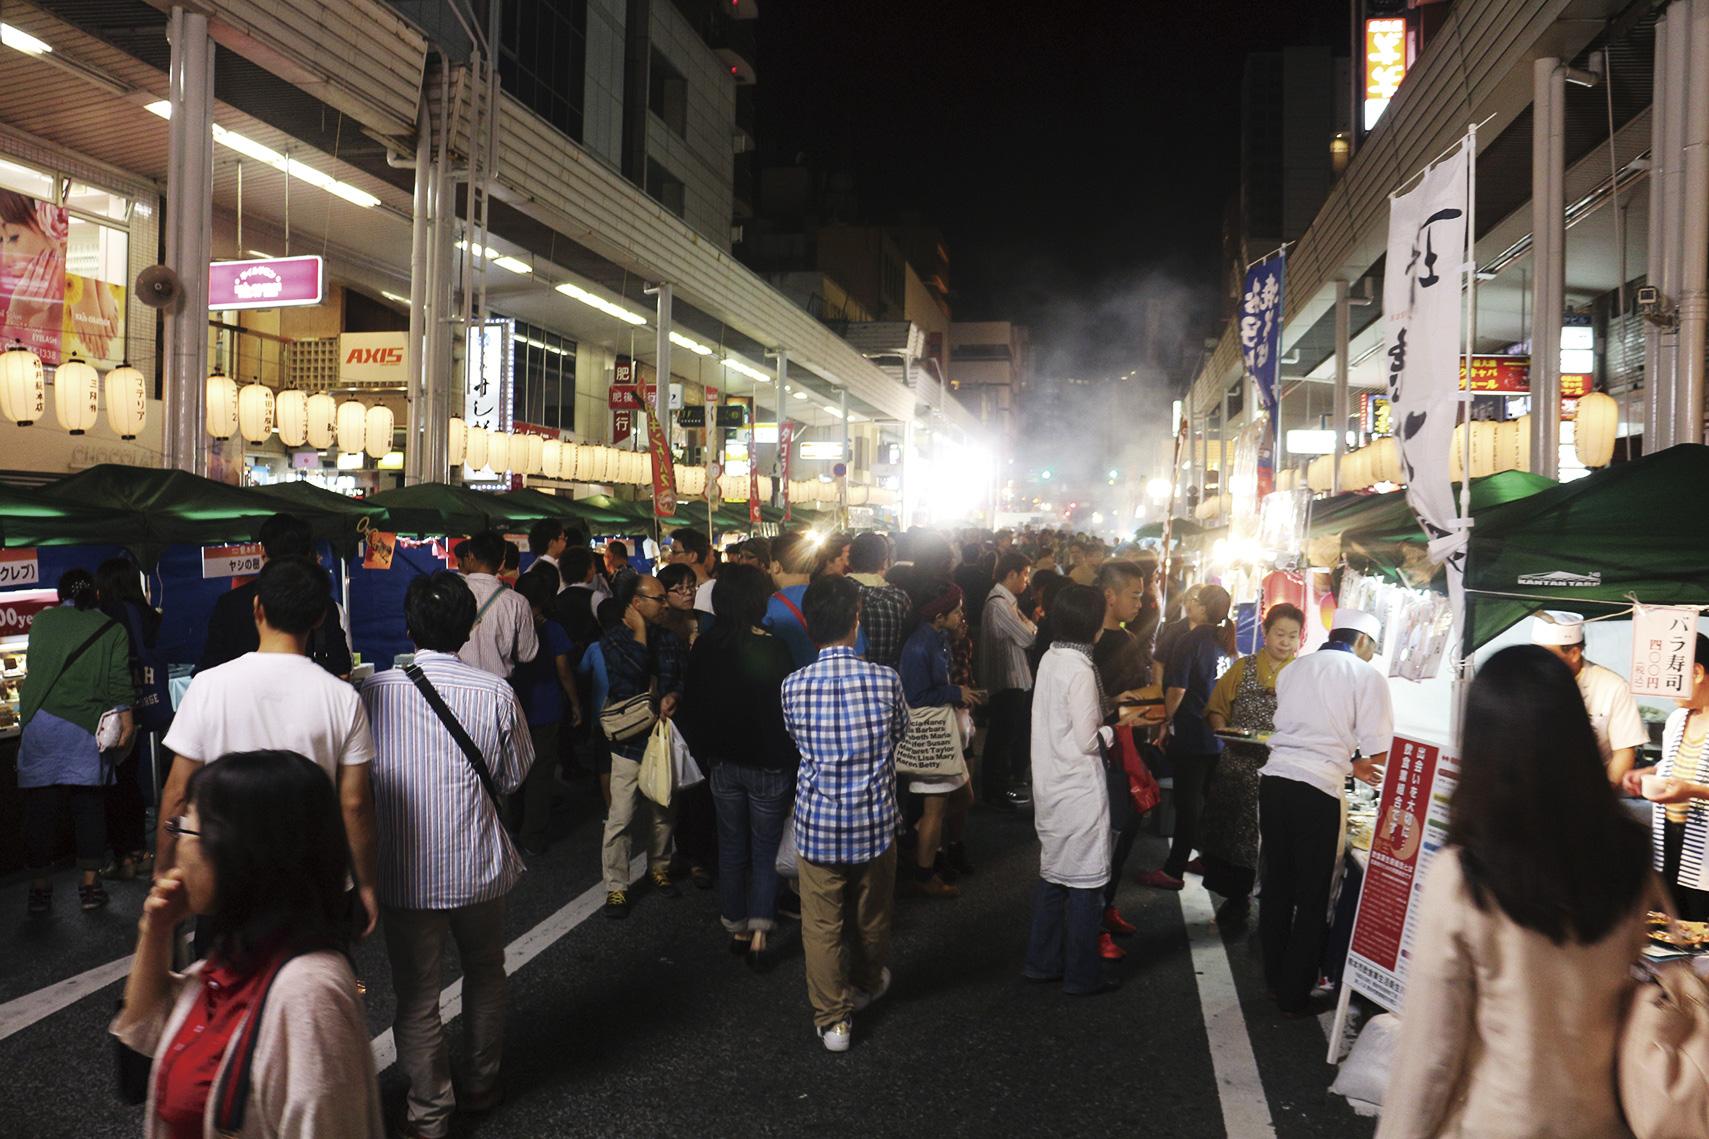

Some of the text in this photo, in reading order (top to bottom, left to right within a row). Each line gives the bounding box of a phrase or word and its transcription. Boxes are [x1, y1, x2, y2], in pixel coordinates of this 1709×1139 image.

[346, 347, 404, 364] AXIS
[612, 391, 657, 404] 肥後行
[616, 366, 630, 432] 肥行
[1518, 579, 1566, 587] KANTAN
[1665, 616, 1690, 692] バラ寿司
[930, 746, 955, 755] Taylor
[896, 757, 940, 769] Karen Betty
[918, 754, 935, 762] Lisa
[935, 753, 955, 761] Mary
